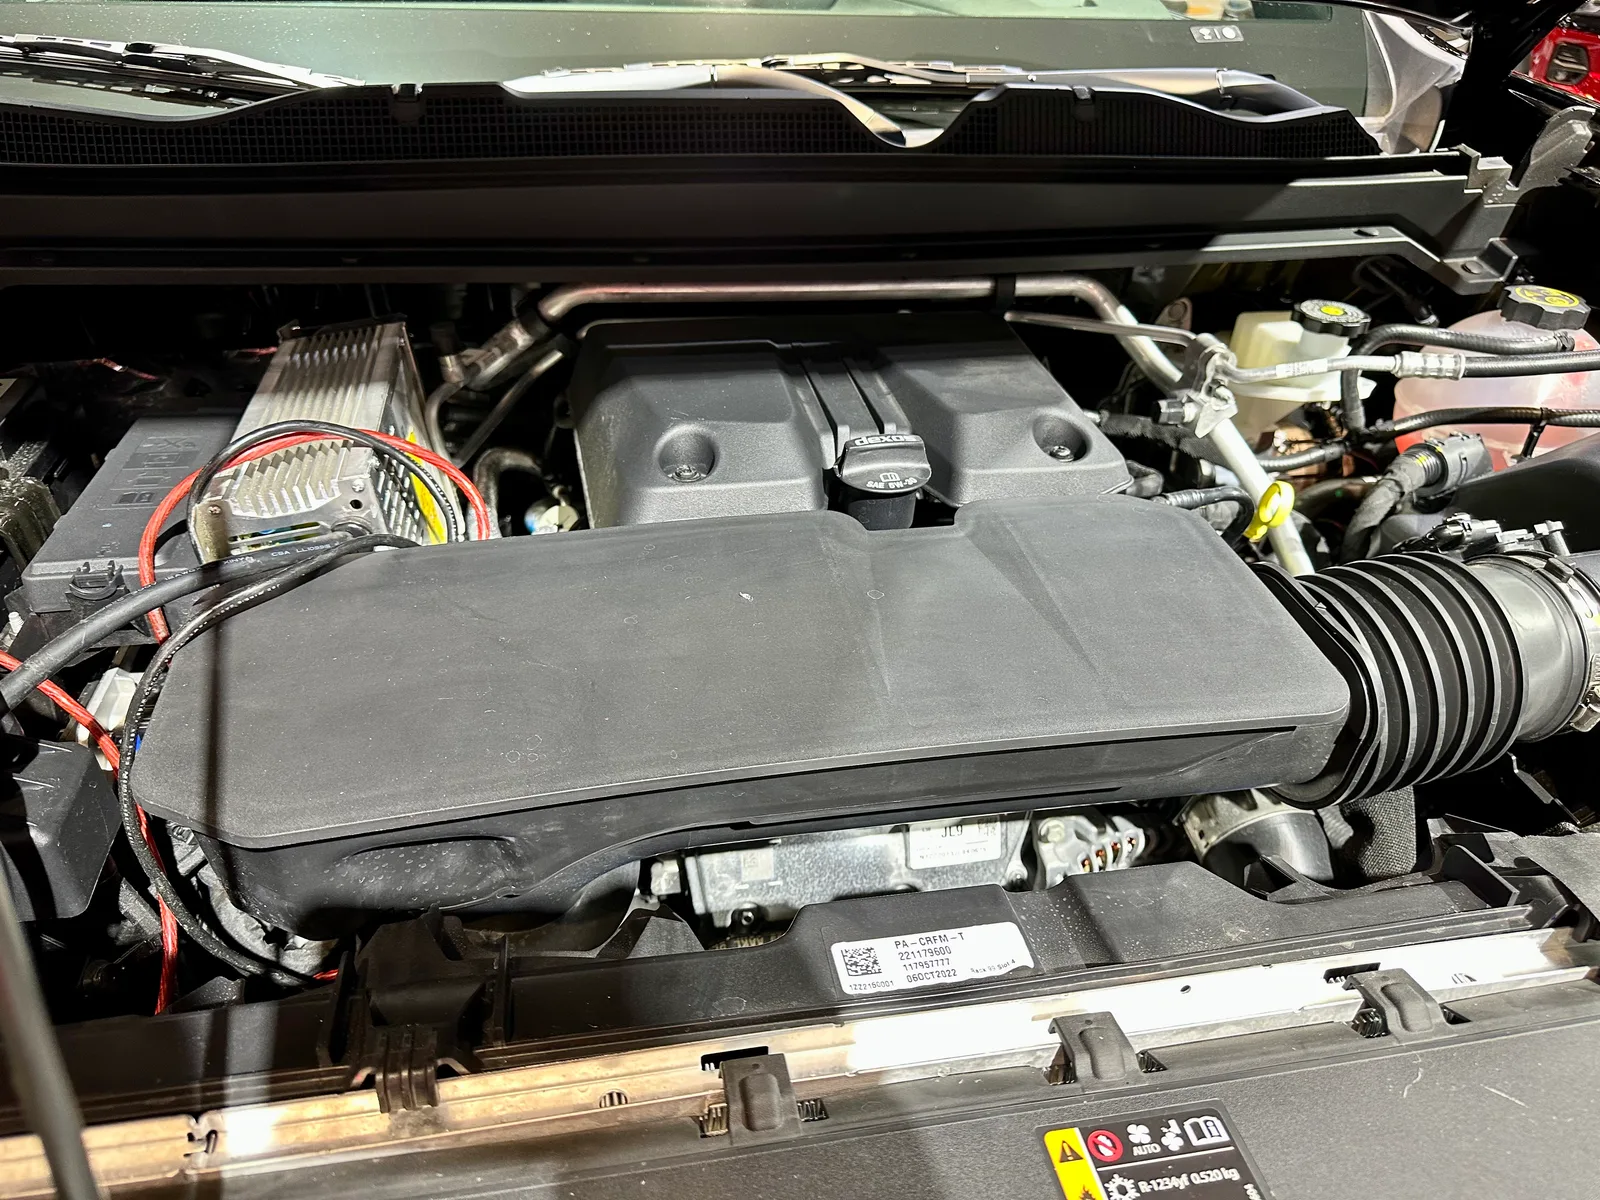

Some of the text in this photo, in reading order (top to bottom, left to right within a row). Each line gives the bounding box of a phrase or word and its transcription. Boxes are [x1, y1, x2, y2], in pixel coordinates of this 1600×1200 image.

[866, 480, 885, 489] SAE
[941, 824, 963, 838] JL9
[894, 932, 964, 949] PA-CRFM-T
[898, 945, 952, 961] 221179600
[903, 957, 950, 971] 117957777
[1132, 1143, 1161, 1157] AUTO
[1138, 1167, 1241, 1193] R-1234yf 0.520 kg
